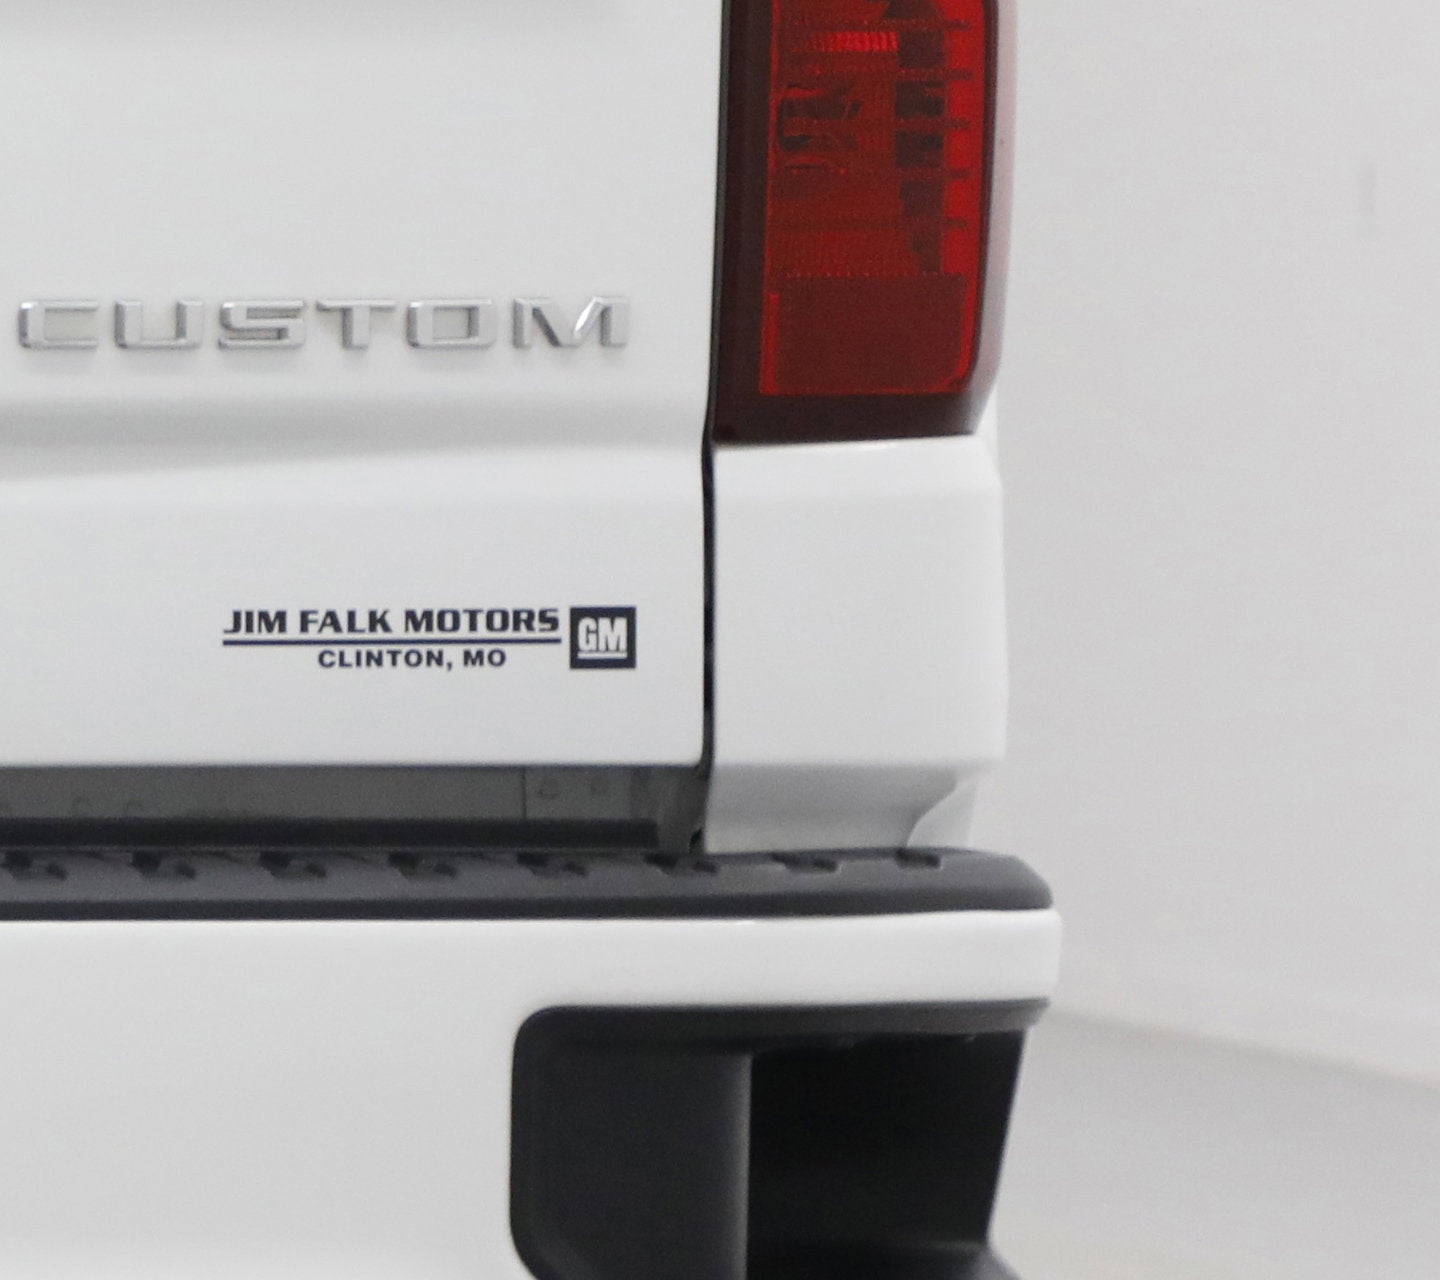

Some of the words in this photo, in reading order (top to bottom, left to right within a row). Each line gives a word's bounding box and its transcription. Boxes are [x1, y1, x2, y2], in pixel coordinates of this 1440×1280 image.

[17, 296, 629, 350] CUSTOM
[223, 609, 287, 634] JIM
[299, 609, 392, 633] FALK
[404, 608, 560, 633] MOTORS
[578, 617, 628, 652] GM
[318, 649, 452, 671] CLINTON,
[463, 649, 507, 668] MO
